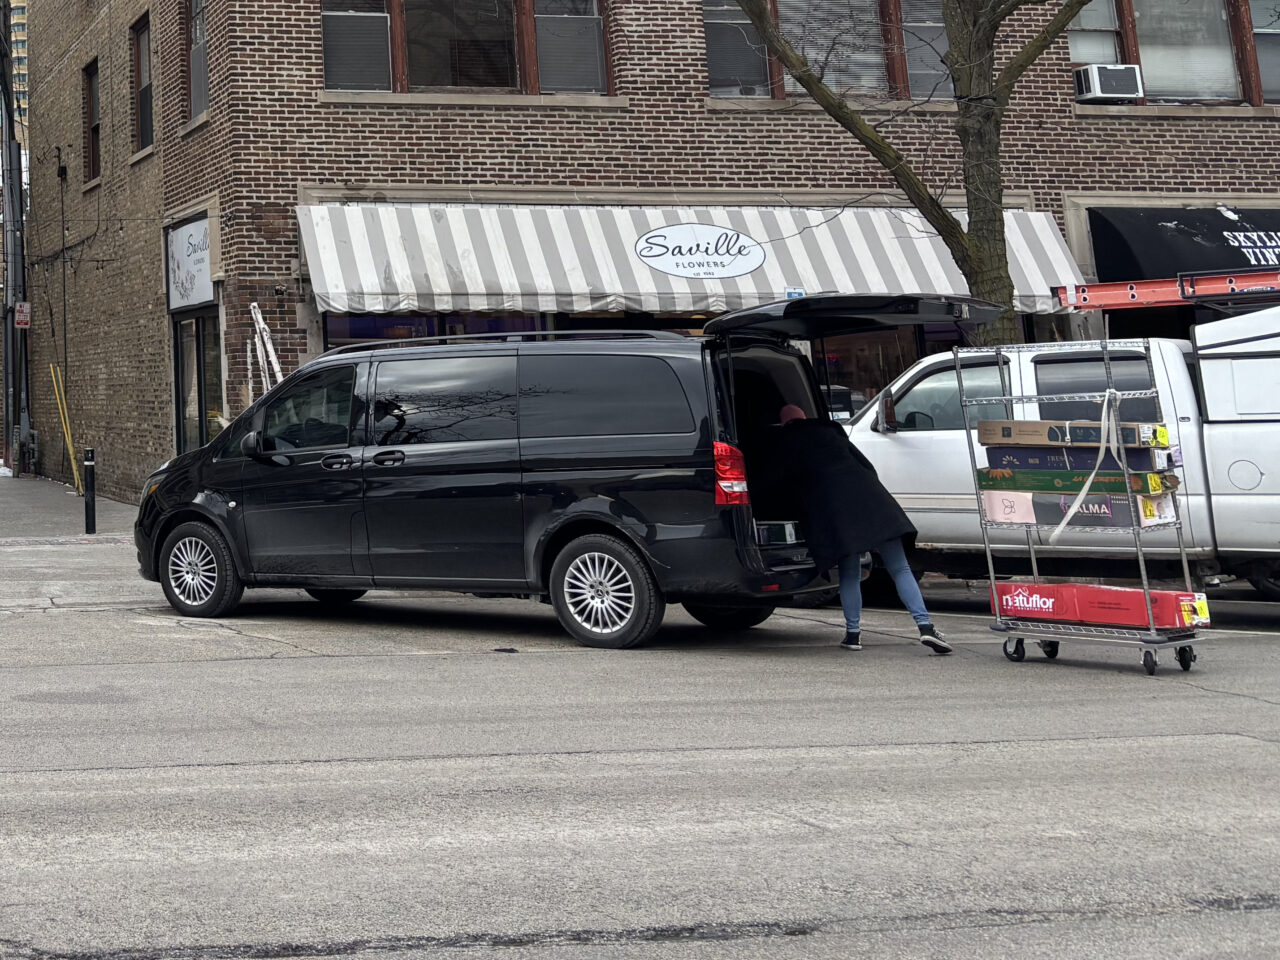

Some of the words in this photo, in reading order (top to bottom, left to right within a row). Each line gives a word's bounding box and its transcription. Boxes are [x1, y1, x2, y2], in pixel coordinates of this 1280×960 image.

[186, 227, 210, 257] Savill
[640, 232, 751, 258] Saville
[675, 261, 726, 269] FLOWERS
[1002, 594, 1055, 609] natuflor
